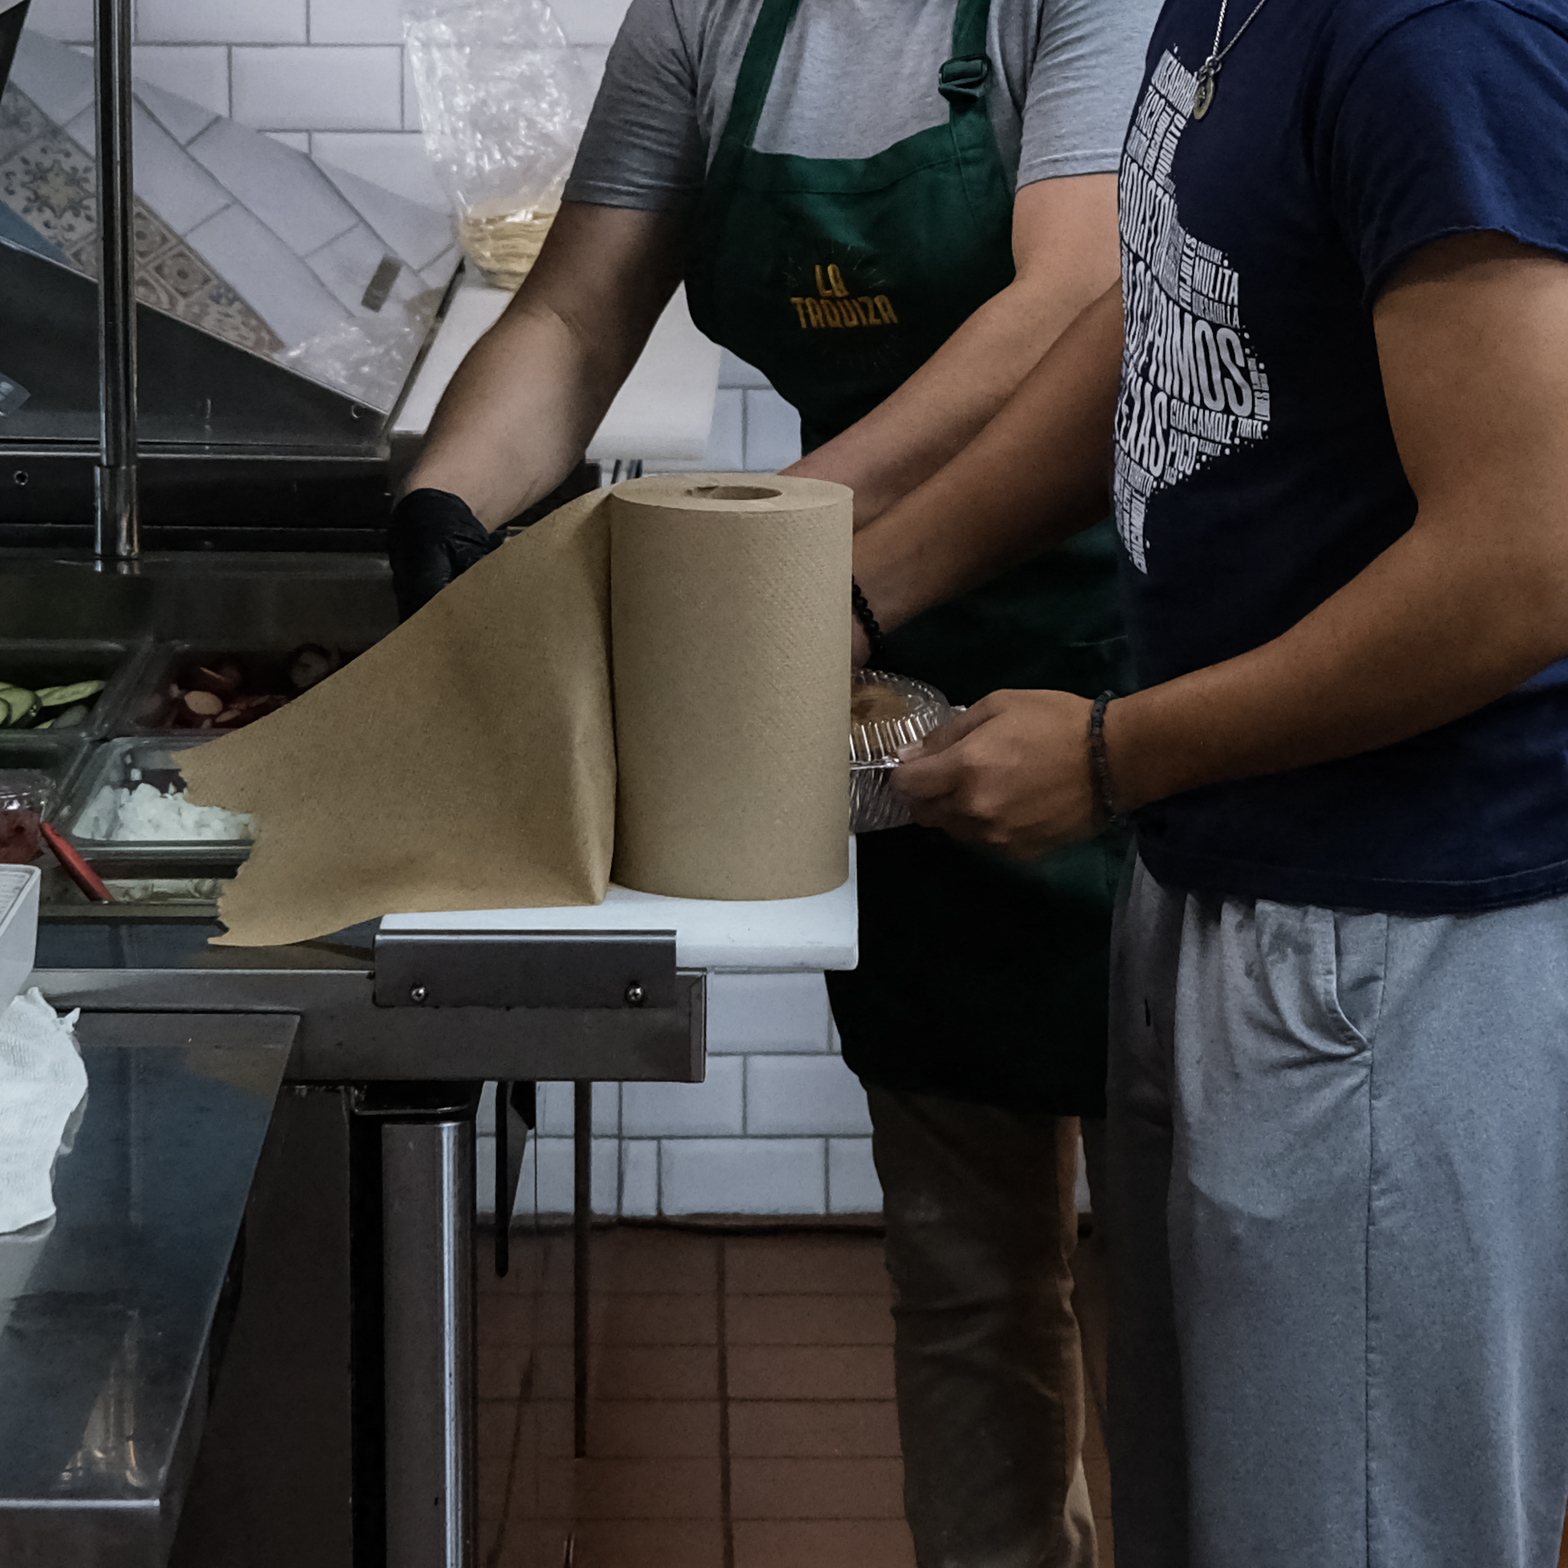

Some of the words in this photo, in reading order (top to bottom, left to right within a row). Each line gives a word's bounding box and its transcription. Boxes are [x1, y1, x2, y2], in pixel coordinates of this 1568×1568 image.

[814, 263, 850, 298] LA
[1192, 256, 1240, 306] MULITA
[790, 295, 899, 330] TAQUIZA
[1137, 278, 1253, 418] PRIMOS
[1169, 398, 1236, 445] GUACAMOLE
[1166, 428, 1199, 476] PICO
